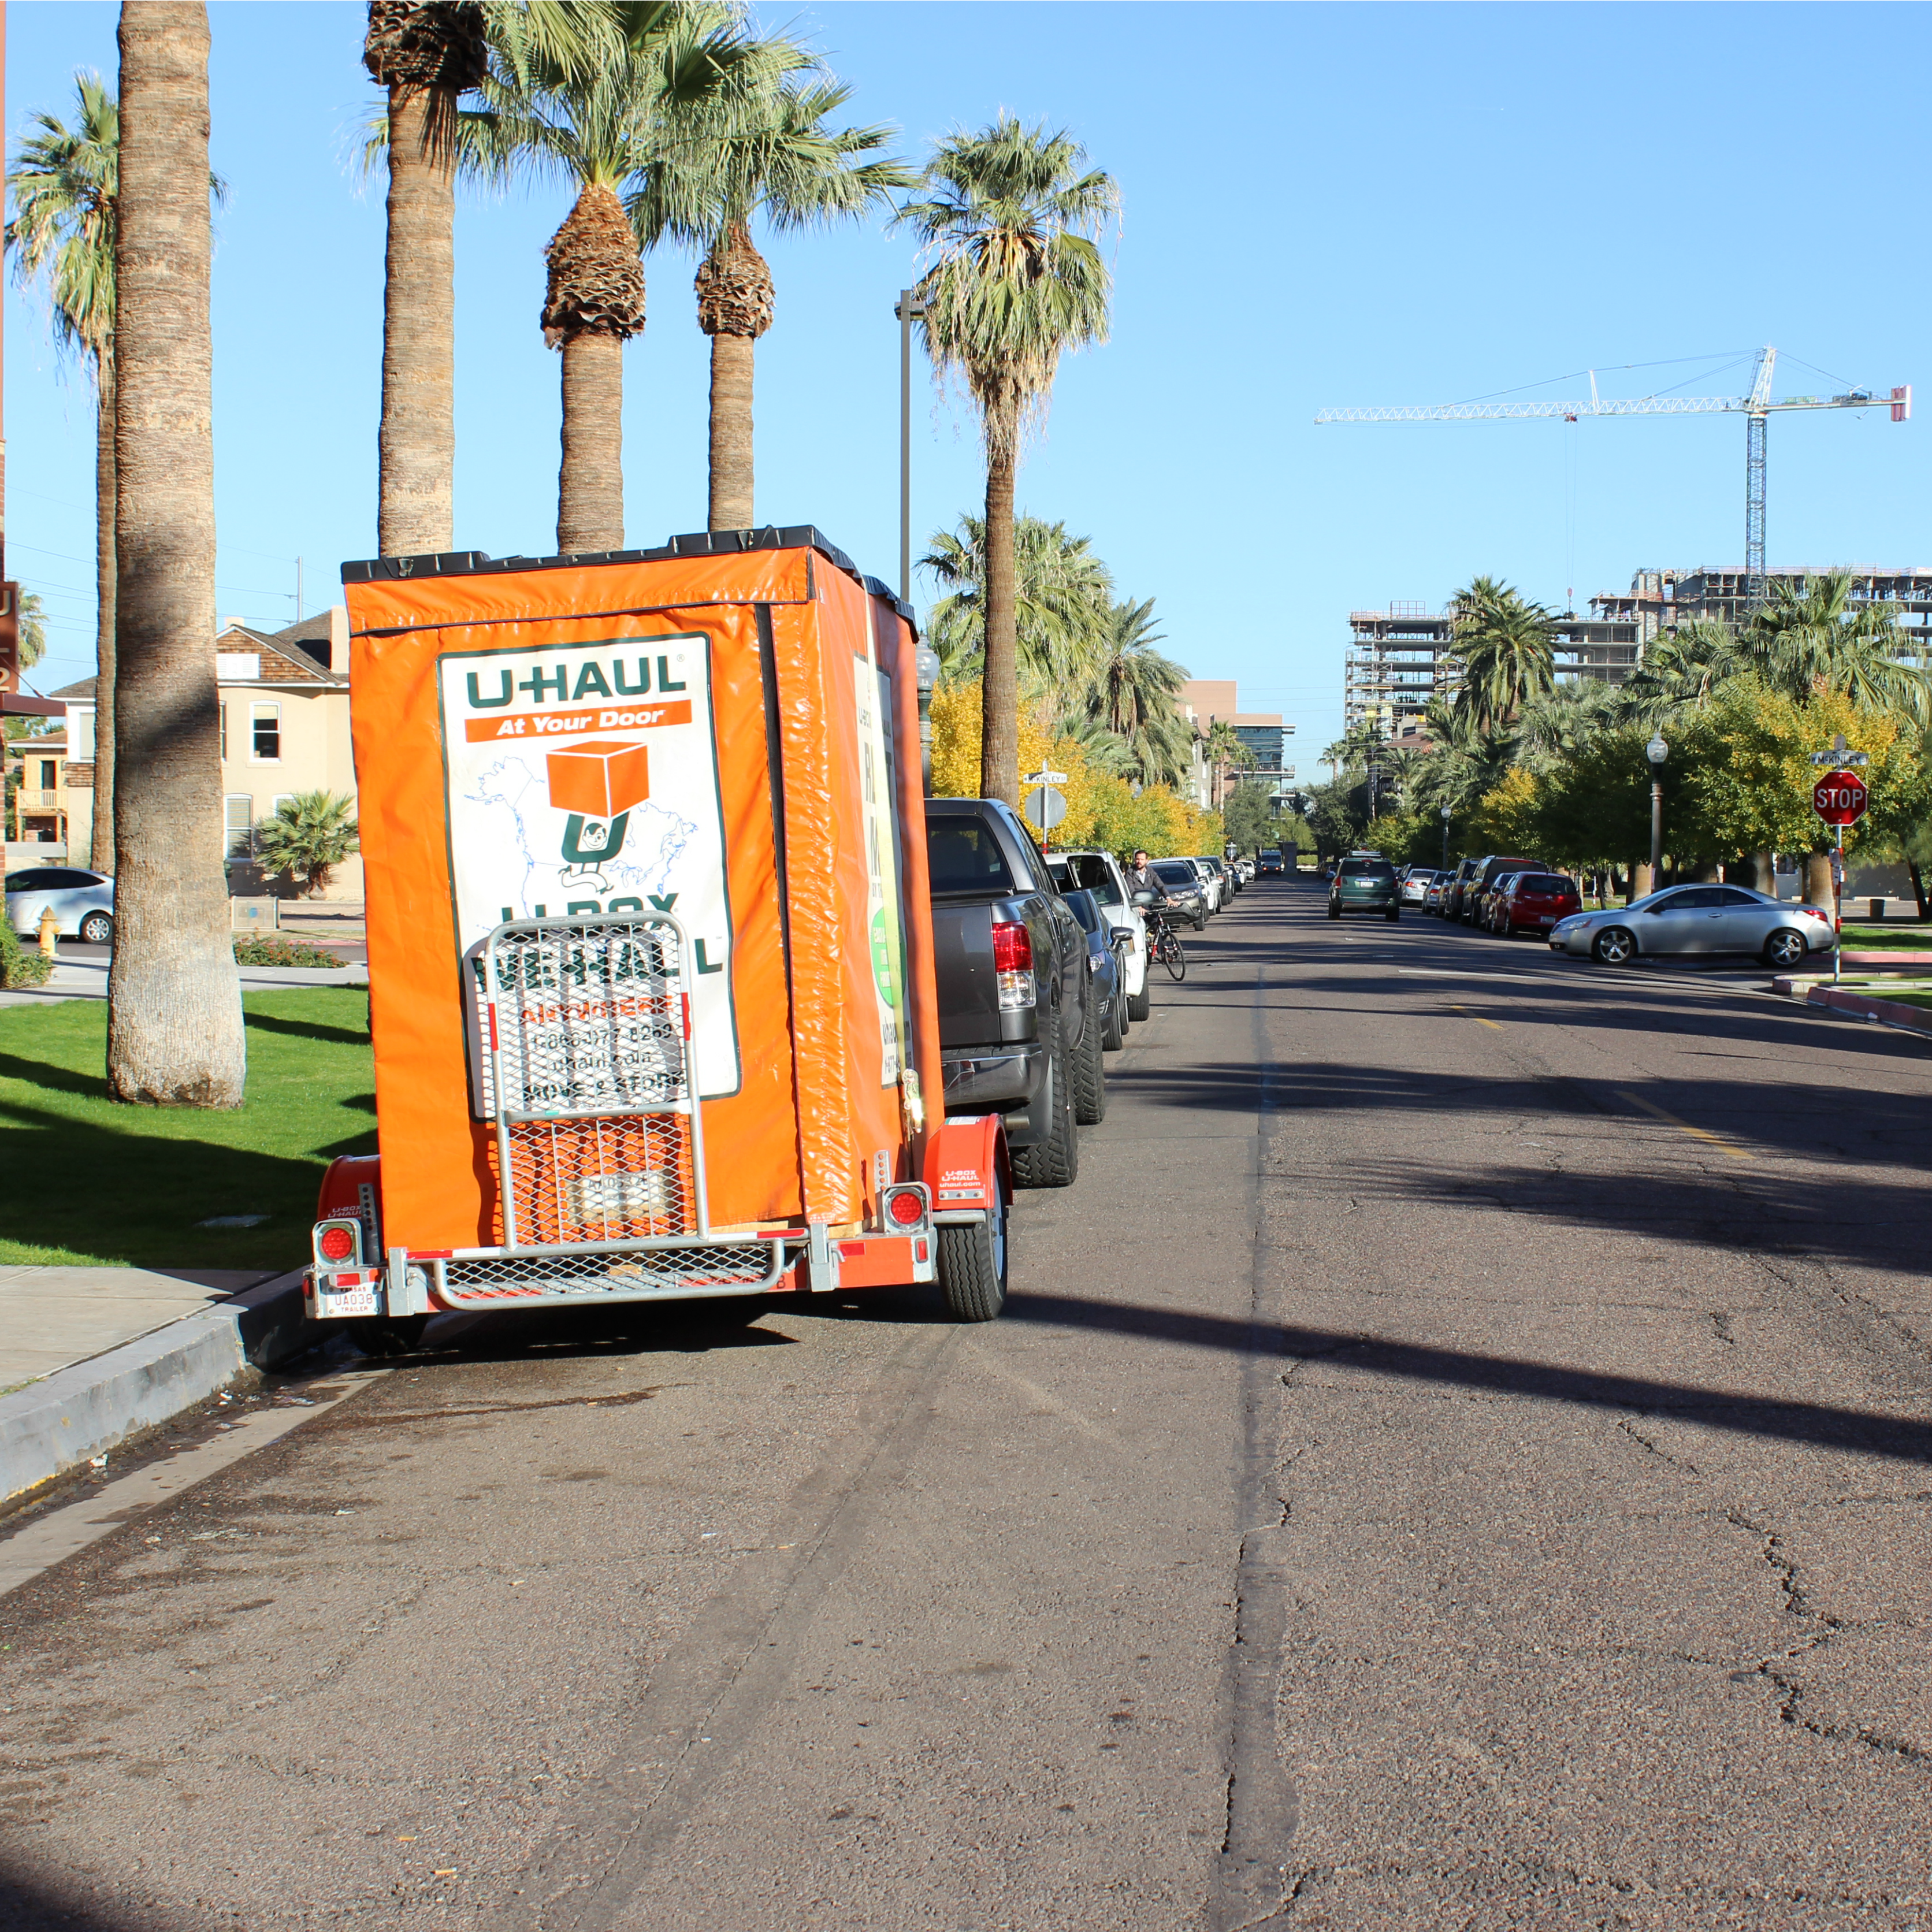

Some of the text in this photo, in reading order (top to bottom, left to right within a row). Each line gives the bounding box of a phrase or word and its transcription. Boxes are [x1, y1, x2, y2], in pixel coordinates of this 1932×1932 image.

[467, 655, 686, 709] U-HAUL
[496, 710, 664, 736] At Your Door
[1816, 789, 1863, 808] STOP
